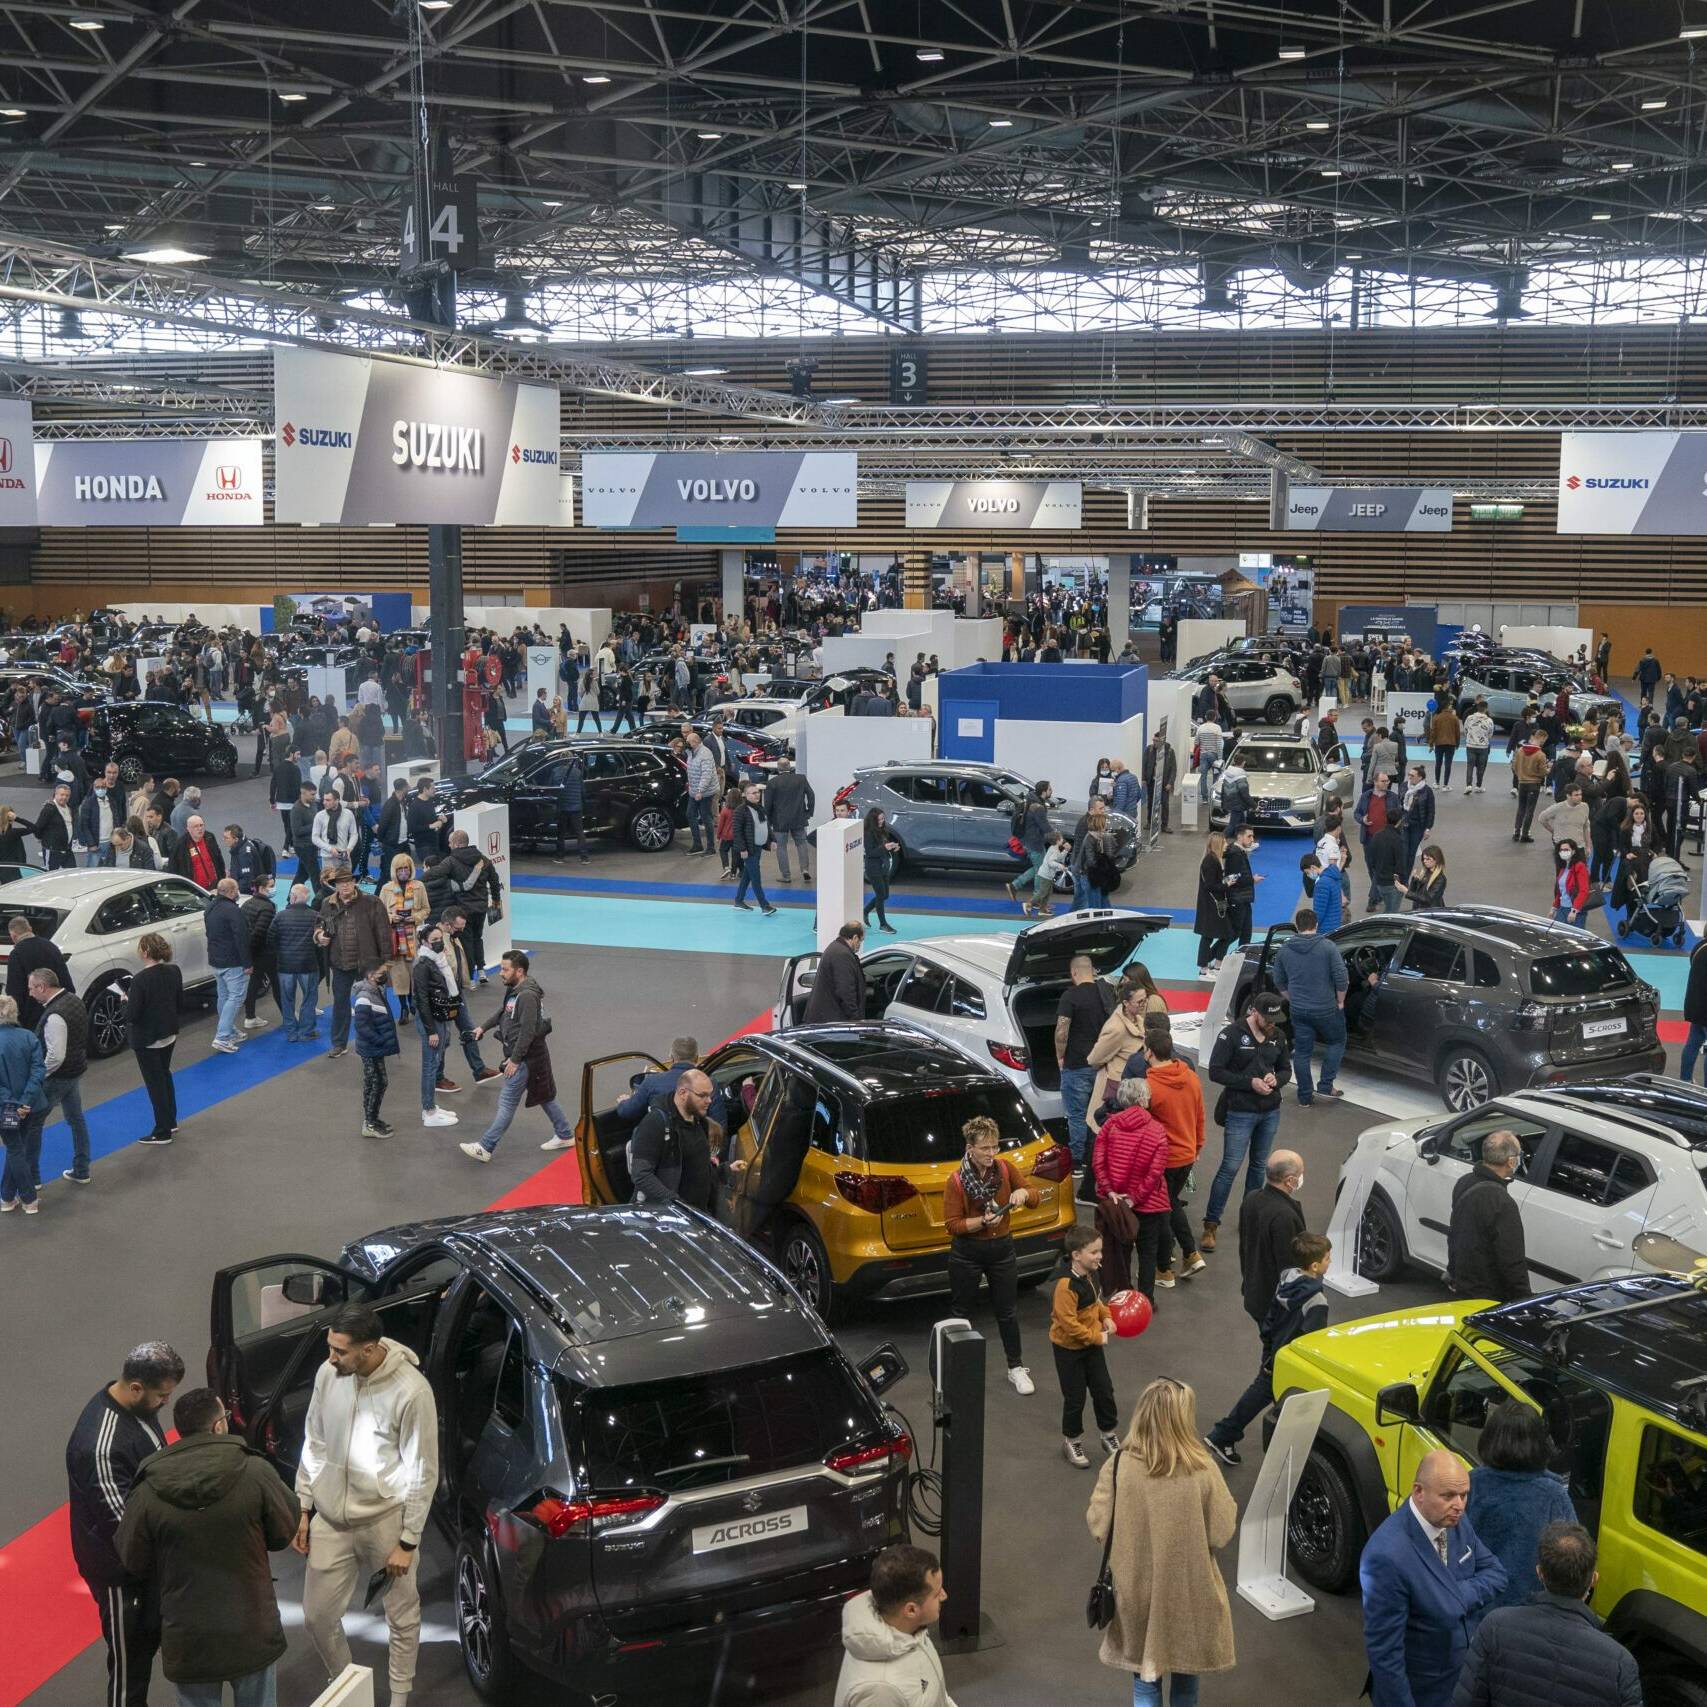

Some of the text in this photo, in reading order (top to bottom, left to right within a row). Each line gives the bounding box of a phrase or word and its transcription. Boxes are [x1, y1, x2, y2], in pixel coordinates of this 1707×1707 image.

[433, 182, 459, 193] HALL
[403, 205, 415, 254] 4
[429, 204, 464, 254] 4
[900, 352, 917, 360] HALL
[901, 361, 917, 388] 3
[299, 427, 352, 448] SUZUKI
[391, 419, 481, 470] SUZUKI
[522, 448, 558, 465] SUZUKI
[74, 475, 163, 500] HONDA
[676, 479, 756, 501] VOLVO
[1585, 478, 1649, 489] SUZUKI
[206, 493, 252, 501] HONDA
[967, 498, 1018, 512] VOLVO
[1289, 503, 1319, 516] Jeep
[1348, 503, 1386, 517] JEEP
[1418, 504, 1449, 517] Jeep
[1395, 707, 1426, 720] Jeep
[1588, 1022, 1622, 1034] S-CROSS
[709, 1513, 792, 1545] ACROSS
